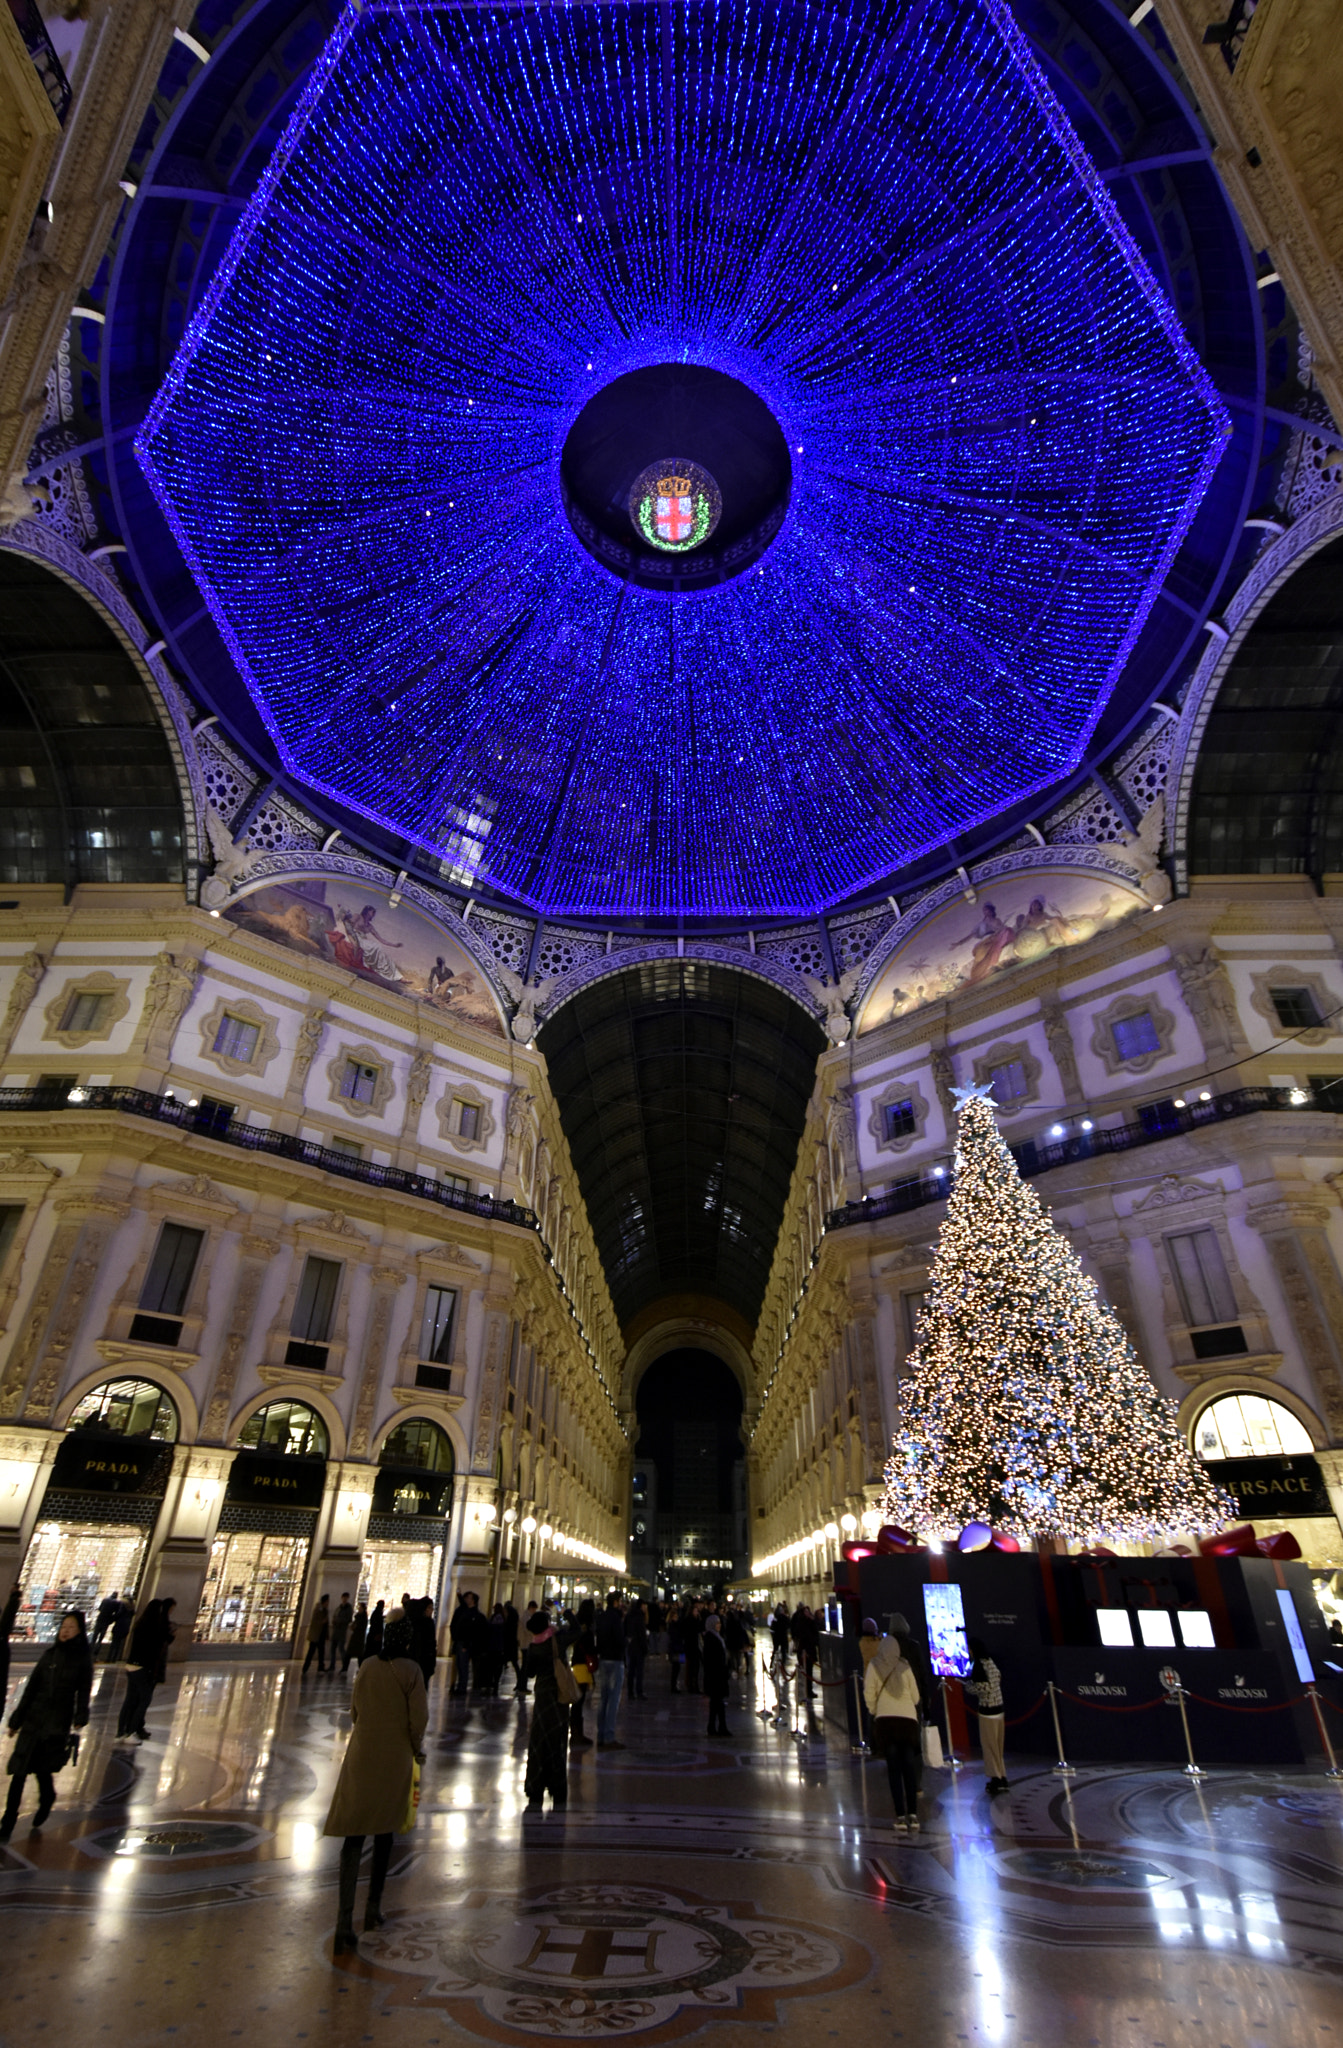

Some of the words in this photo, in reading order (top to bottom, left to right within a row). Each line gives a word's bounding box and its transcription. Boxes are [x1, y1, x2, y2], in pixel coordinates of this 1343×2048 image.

[85, 1460, 139, 1475] PRADA
[253, 1475, 298, 1489] PRADA
[393, 1489, 430, 1500] PRADA
[1077, 1685, 1128, 1696] SWAROVSKI
[1218, 1688, 1268, 1699] SWAROVSKI
